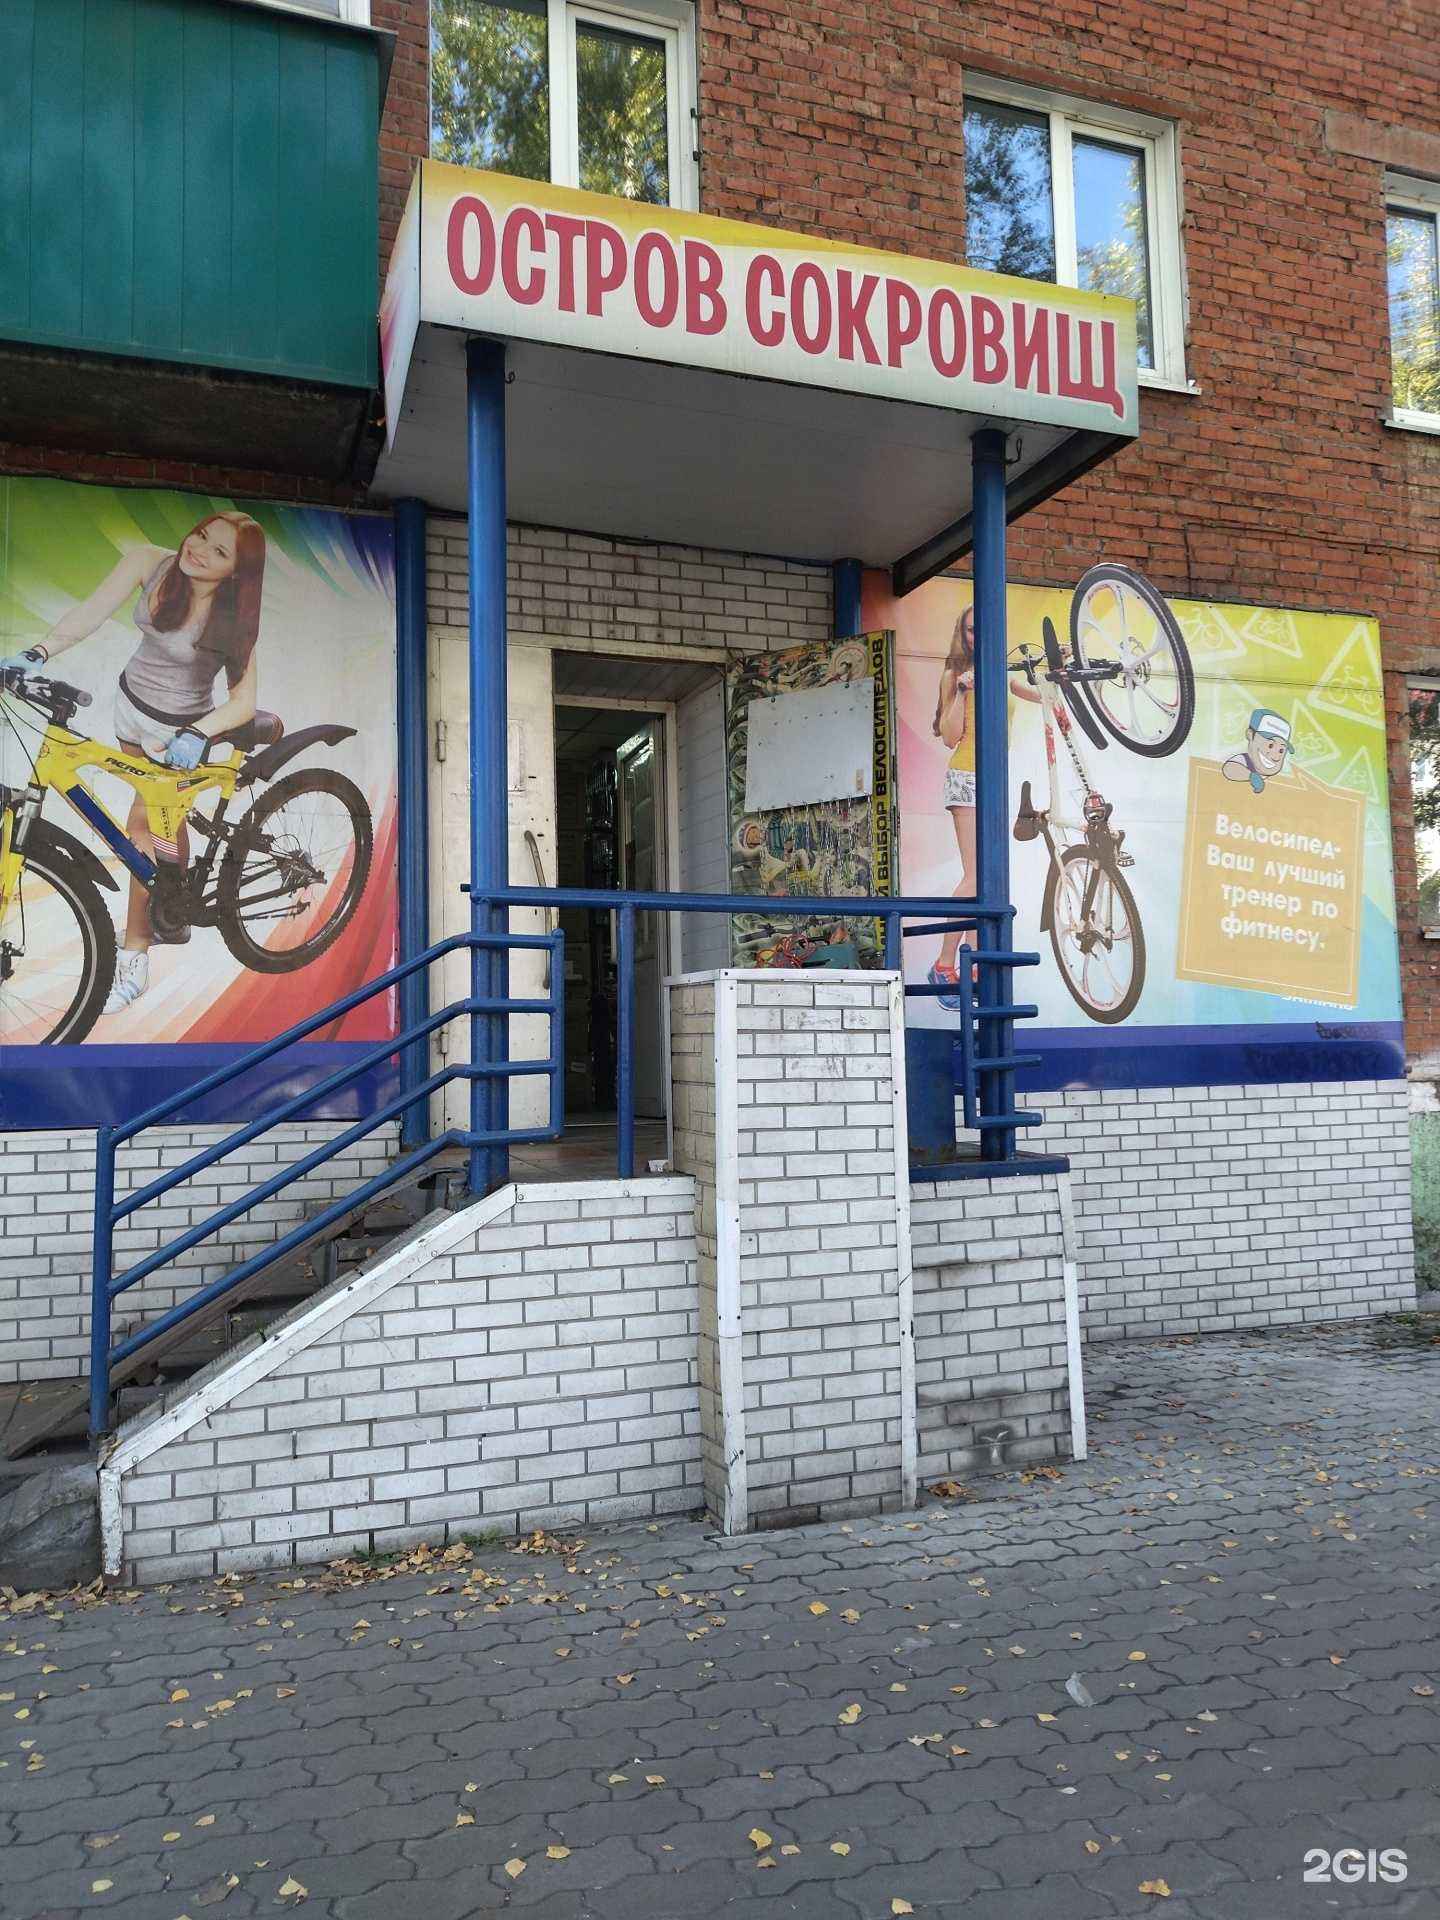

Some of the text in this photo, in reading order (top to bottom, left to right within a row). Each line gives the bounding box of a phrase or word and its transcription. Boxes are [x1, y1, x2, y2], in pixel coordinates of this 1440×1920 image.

[446, 195, 1125, 419] ОСТРОВ СОКРОВИЩ
[872, 638, 887, 797] ВЕЛОСИПЕДОВ
[876, 801, 889, 881] ВЫБОР
[1215, 813, 1341, 860] Велосипед-
[1207, 844, 1346, 890] Ваш лучший
[1221, 883, 1338, 919] тренер по
[1220, 911, 1326, 952] фитнесу.
